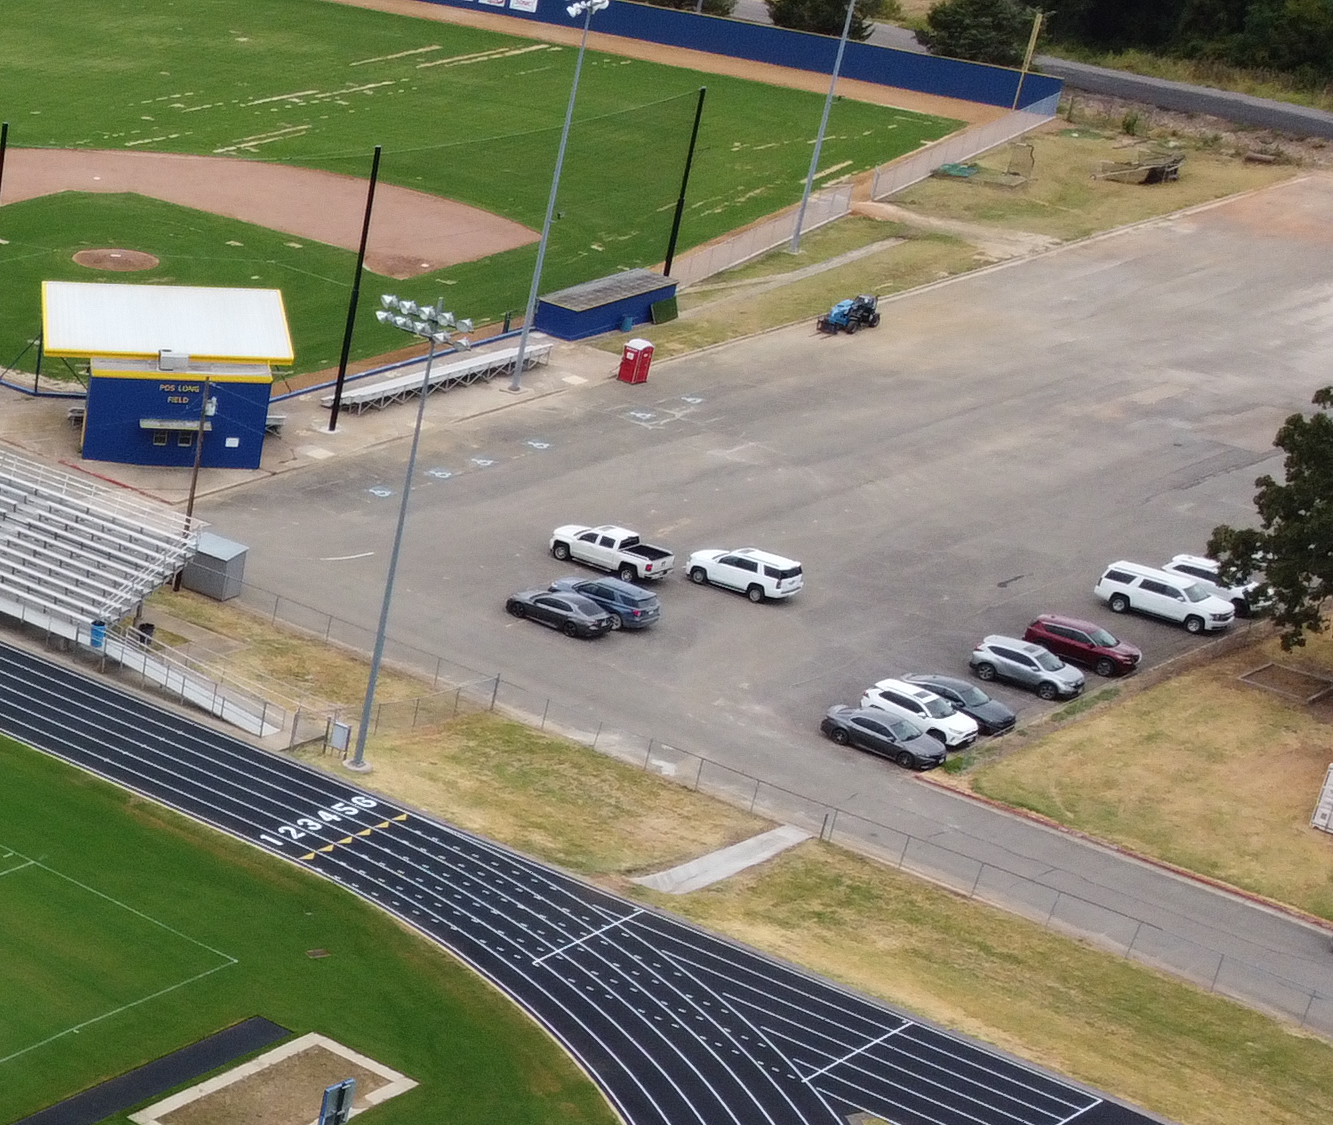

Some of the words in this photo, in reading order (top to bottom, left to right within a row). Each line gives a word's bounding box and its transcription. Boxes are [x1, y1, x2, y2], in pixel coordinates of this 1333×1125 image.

[259, 833, 283, 846] 1
[278, 825, 306, 840] 2
[297, 817, 322, 832] 3
[317, 809, 342, 823] 4
[331, 802, 359, 816] 5
[351, 796, 377, 809] 6
